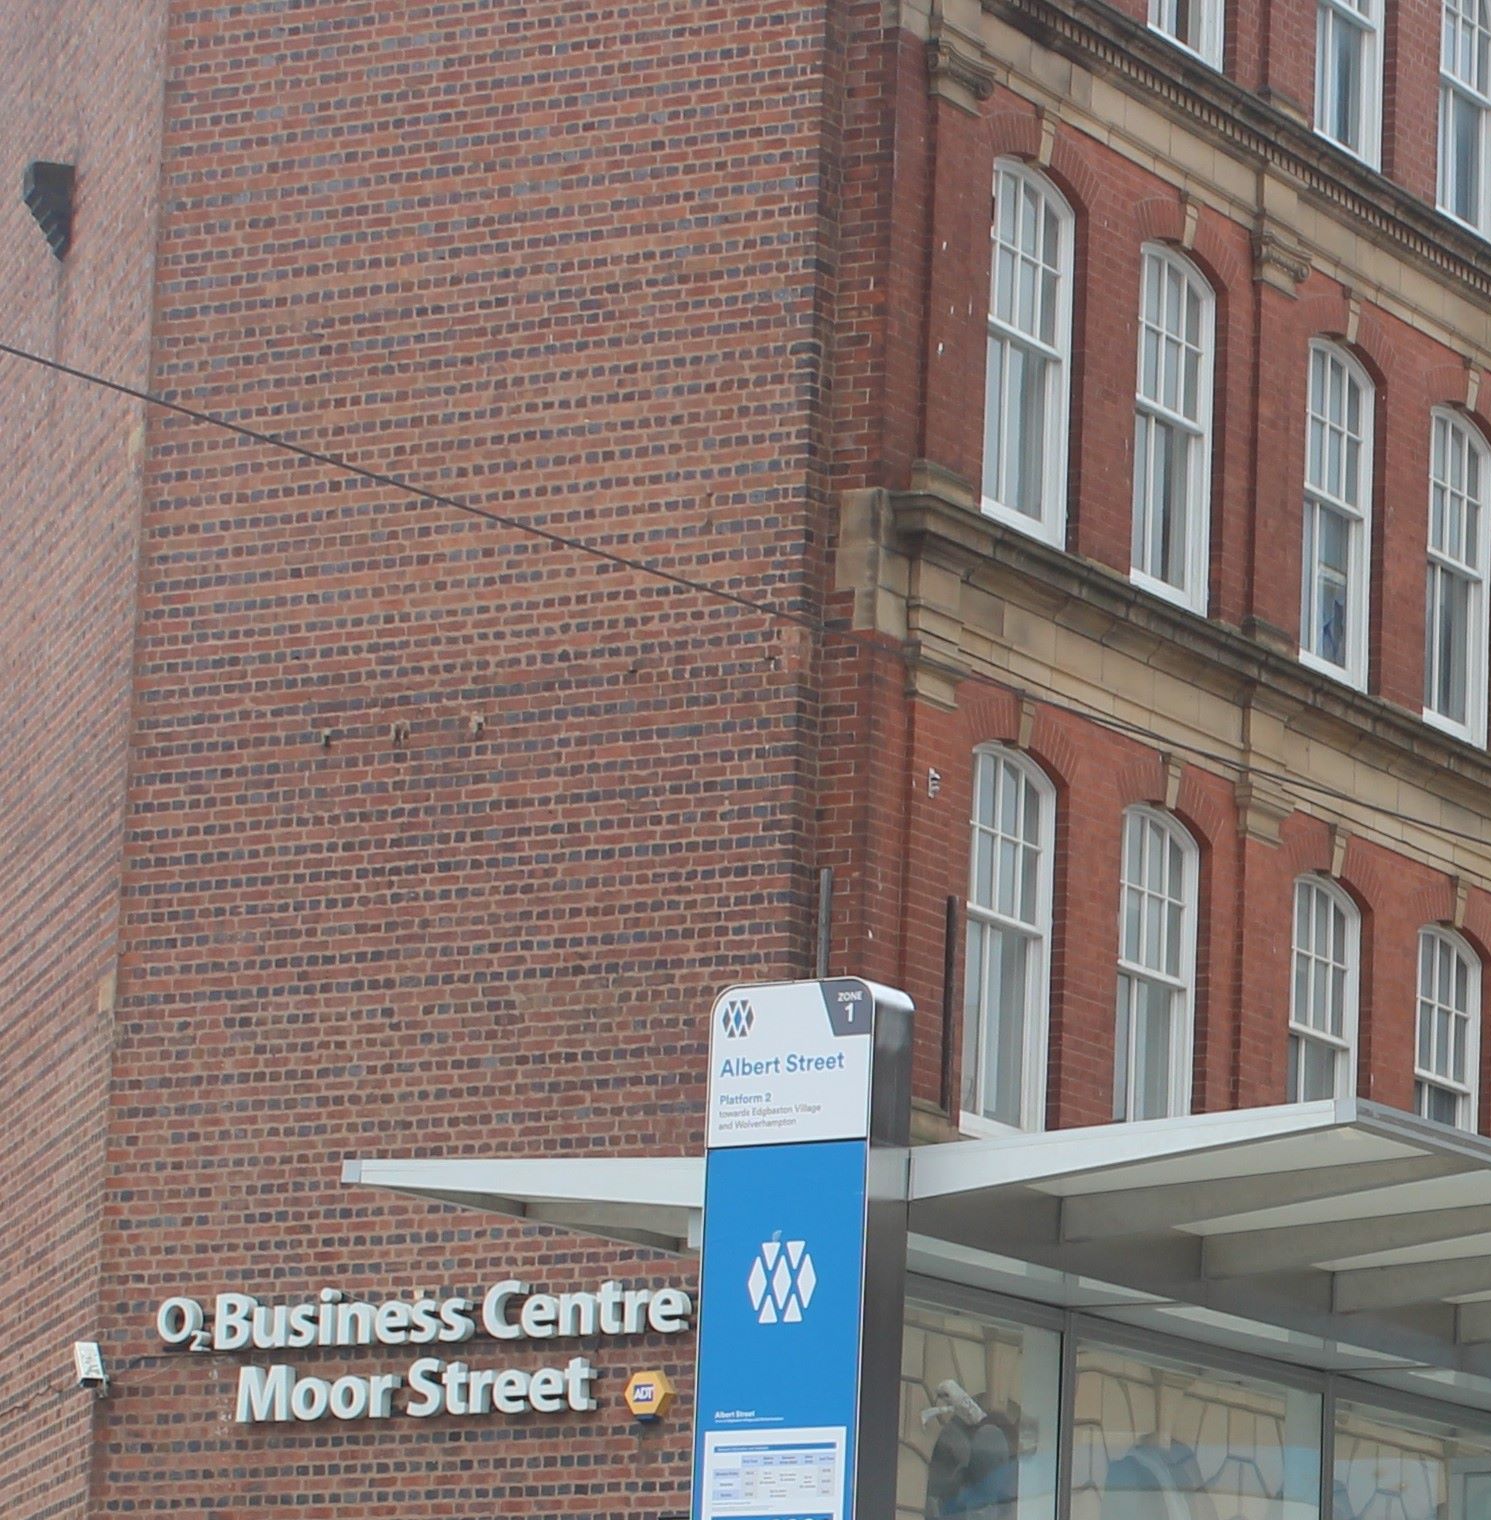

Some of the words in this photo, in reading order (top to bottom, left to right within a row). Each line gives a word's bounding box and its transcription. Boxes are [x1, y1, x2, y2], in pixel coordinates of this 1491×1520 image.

[837, 991, 863, 1002] ZONE
[844, 1003, 854, 1022] 1
[720, 1057, 780, 1078] Albert
[786, 1052, 845, 1072] Street
[719, 1094, 763, 1105] Platform
[765, 1093, 772, 1102] 2
[719, 1108, 750, 1118] towards
[752, 1107, 793, 1117] Edgbaston
[794, 1104, 821, 1113] Village
[719, 1121, 733, 1130] and
[735, 1118, 797, 1129] Wolverhampton
[213, 1287, 476, 1351] Business
[482, 1279, 693, 1340] Centre
[235, 1363, 401, 1423] Moor
[405, 1356, 598, 1418] Street
[634, 1387, 655, 1400] ADT
[714, 1410, 734, 1418] Albert
